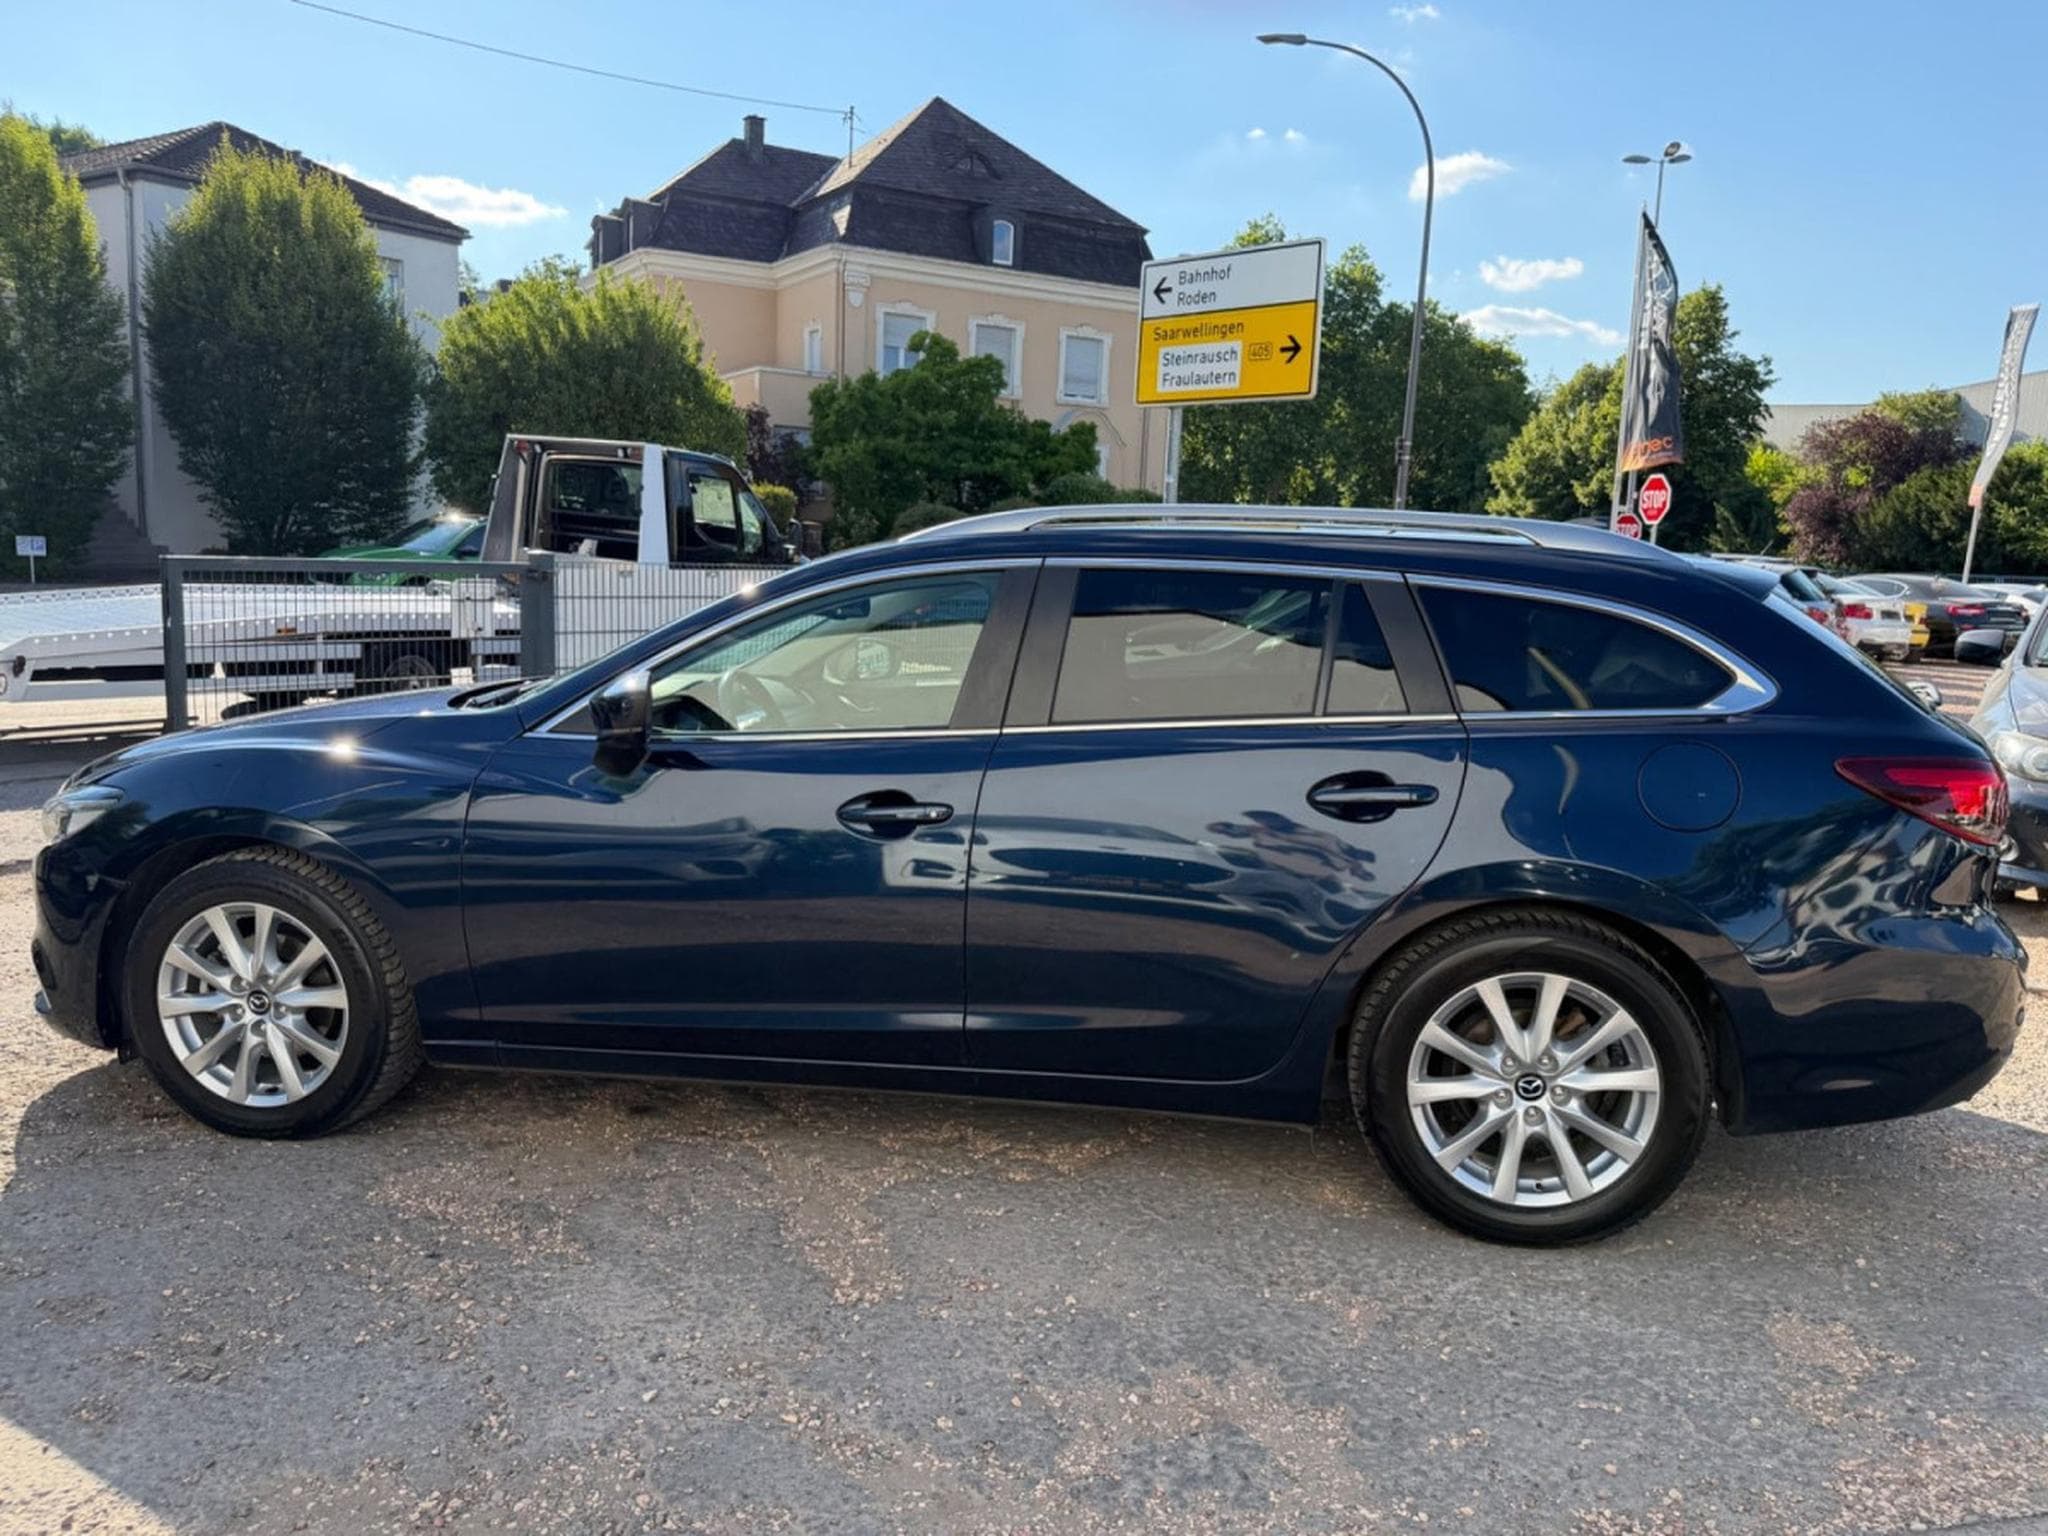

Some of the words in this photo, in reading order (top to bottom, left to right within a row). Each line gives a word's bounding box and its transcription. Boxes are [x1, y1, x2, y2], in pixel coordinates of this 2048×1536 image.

[1178, 263, 1232, 286] Bahnhof
[1177, 290, 1216, 307] Roden
[1153, 321, 1244, 342] Saarwellingen
[1162, 346, 1238, 367] Steinrausch
[1162, 370, 1237, 387] Fraulautern
[1643, 489, 1667, 509] STOP
